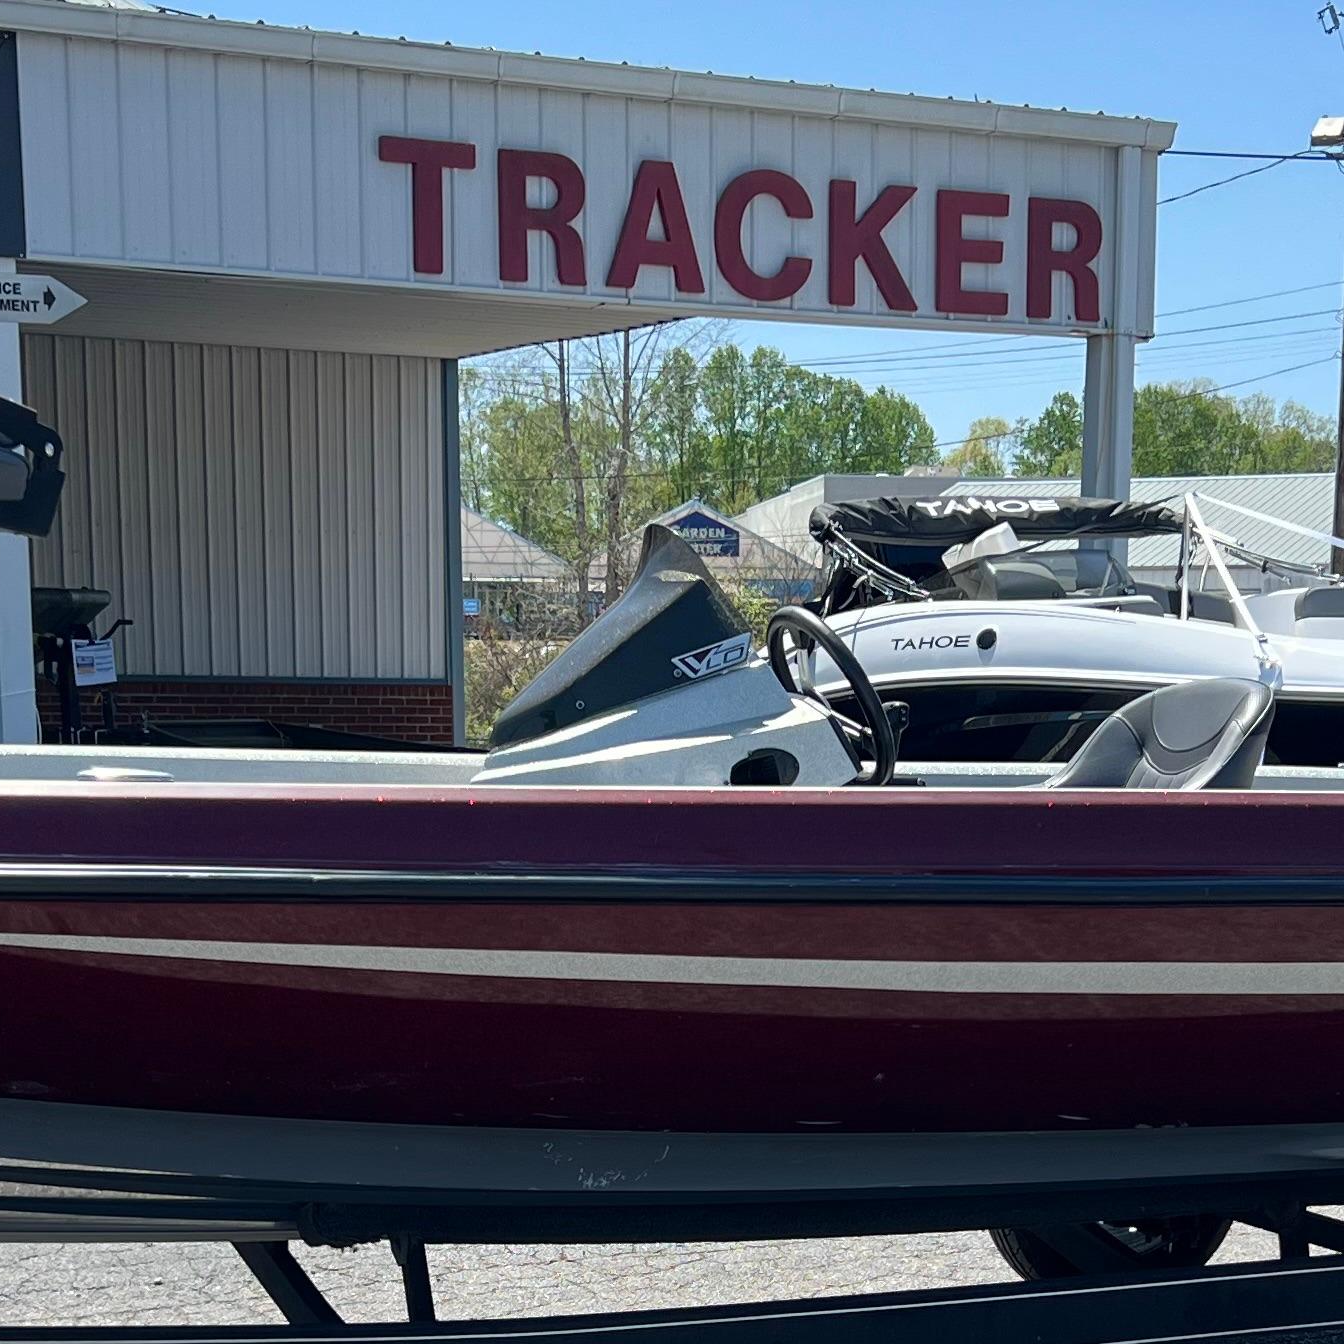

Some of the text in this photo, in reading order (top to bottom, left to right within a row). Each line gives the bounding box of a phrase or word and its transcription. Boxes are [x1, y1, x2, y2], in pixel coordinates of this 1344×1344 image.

[378, 135, 1104, 322] TRACKER
[916, 497, 1060, 517] TAHOE
[891, 635, 971, 650] TAHOE
